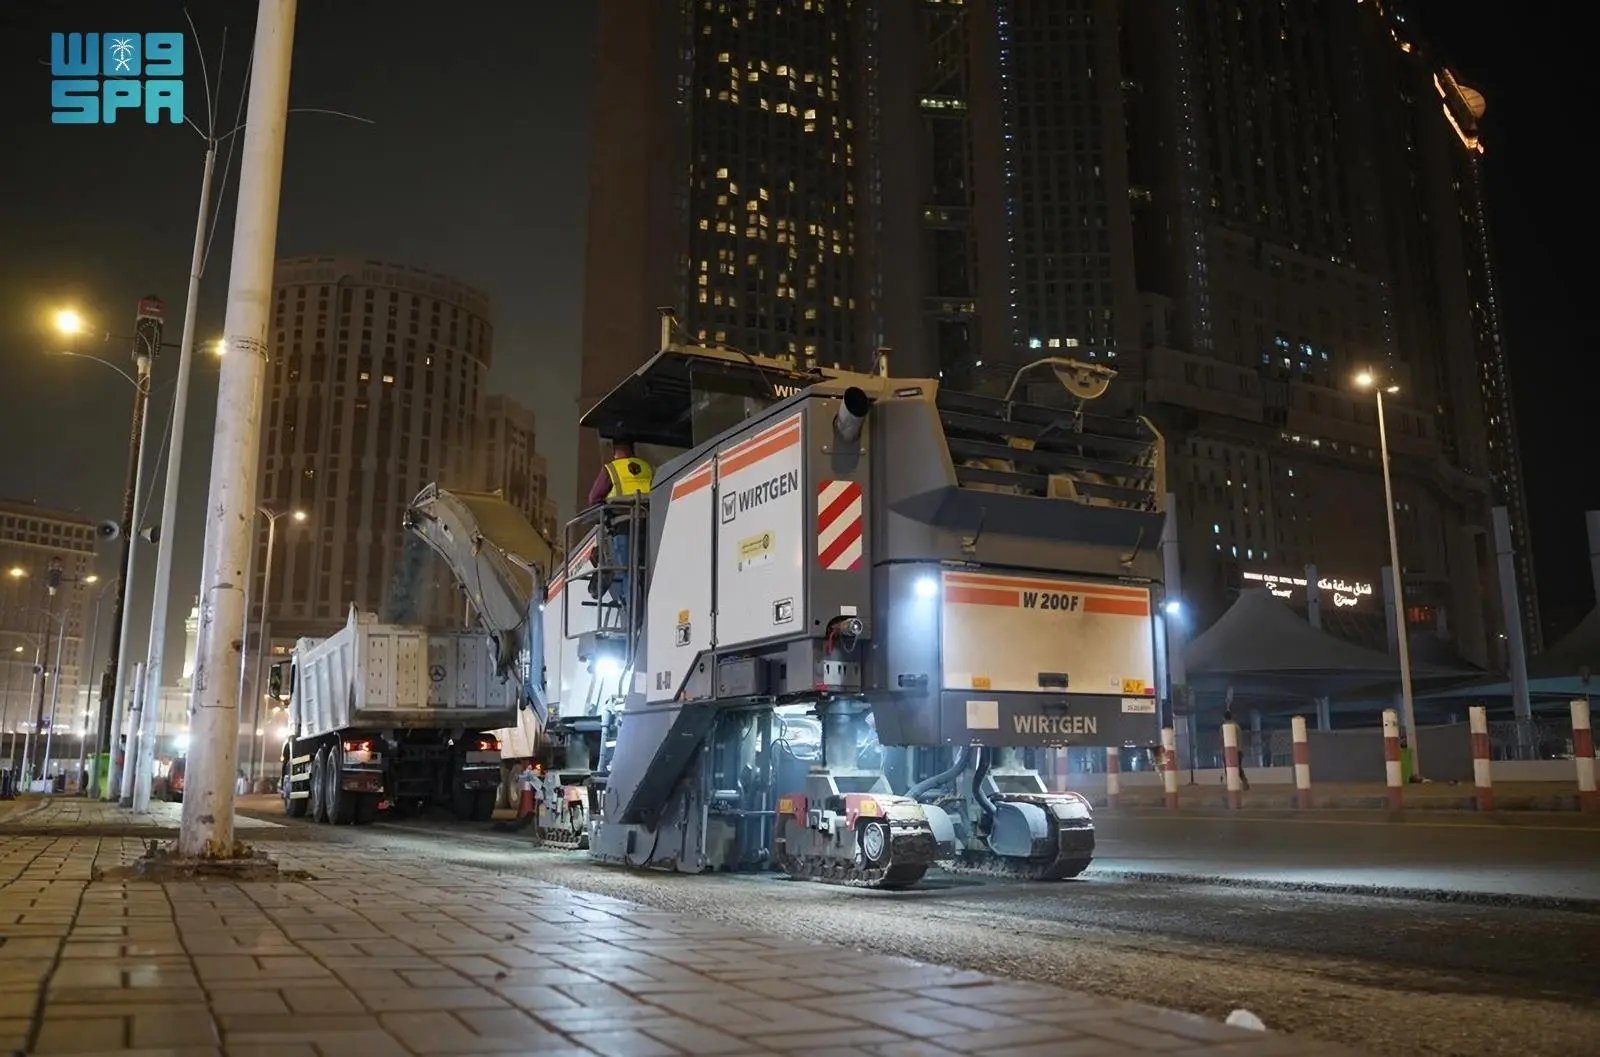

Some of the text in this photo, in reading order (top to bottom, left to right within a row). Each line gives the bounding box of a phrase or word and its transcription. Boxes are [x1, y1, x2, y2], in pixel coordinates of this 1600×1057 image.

[738, 469, 798, 512] WIRTGEN
[1023, 591, 1079, 611] W 200F
[1013, 715, 1097, 734] WIRTGEN
